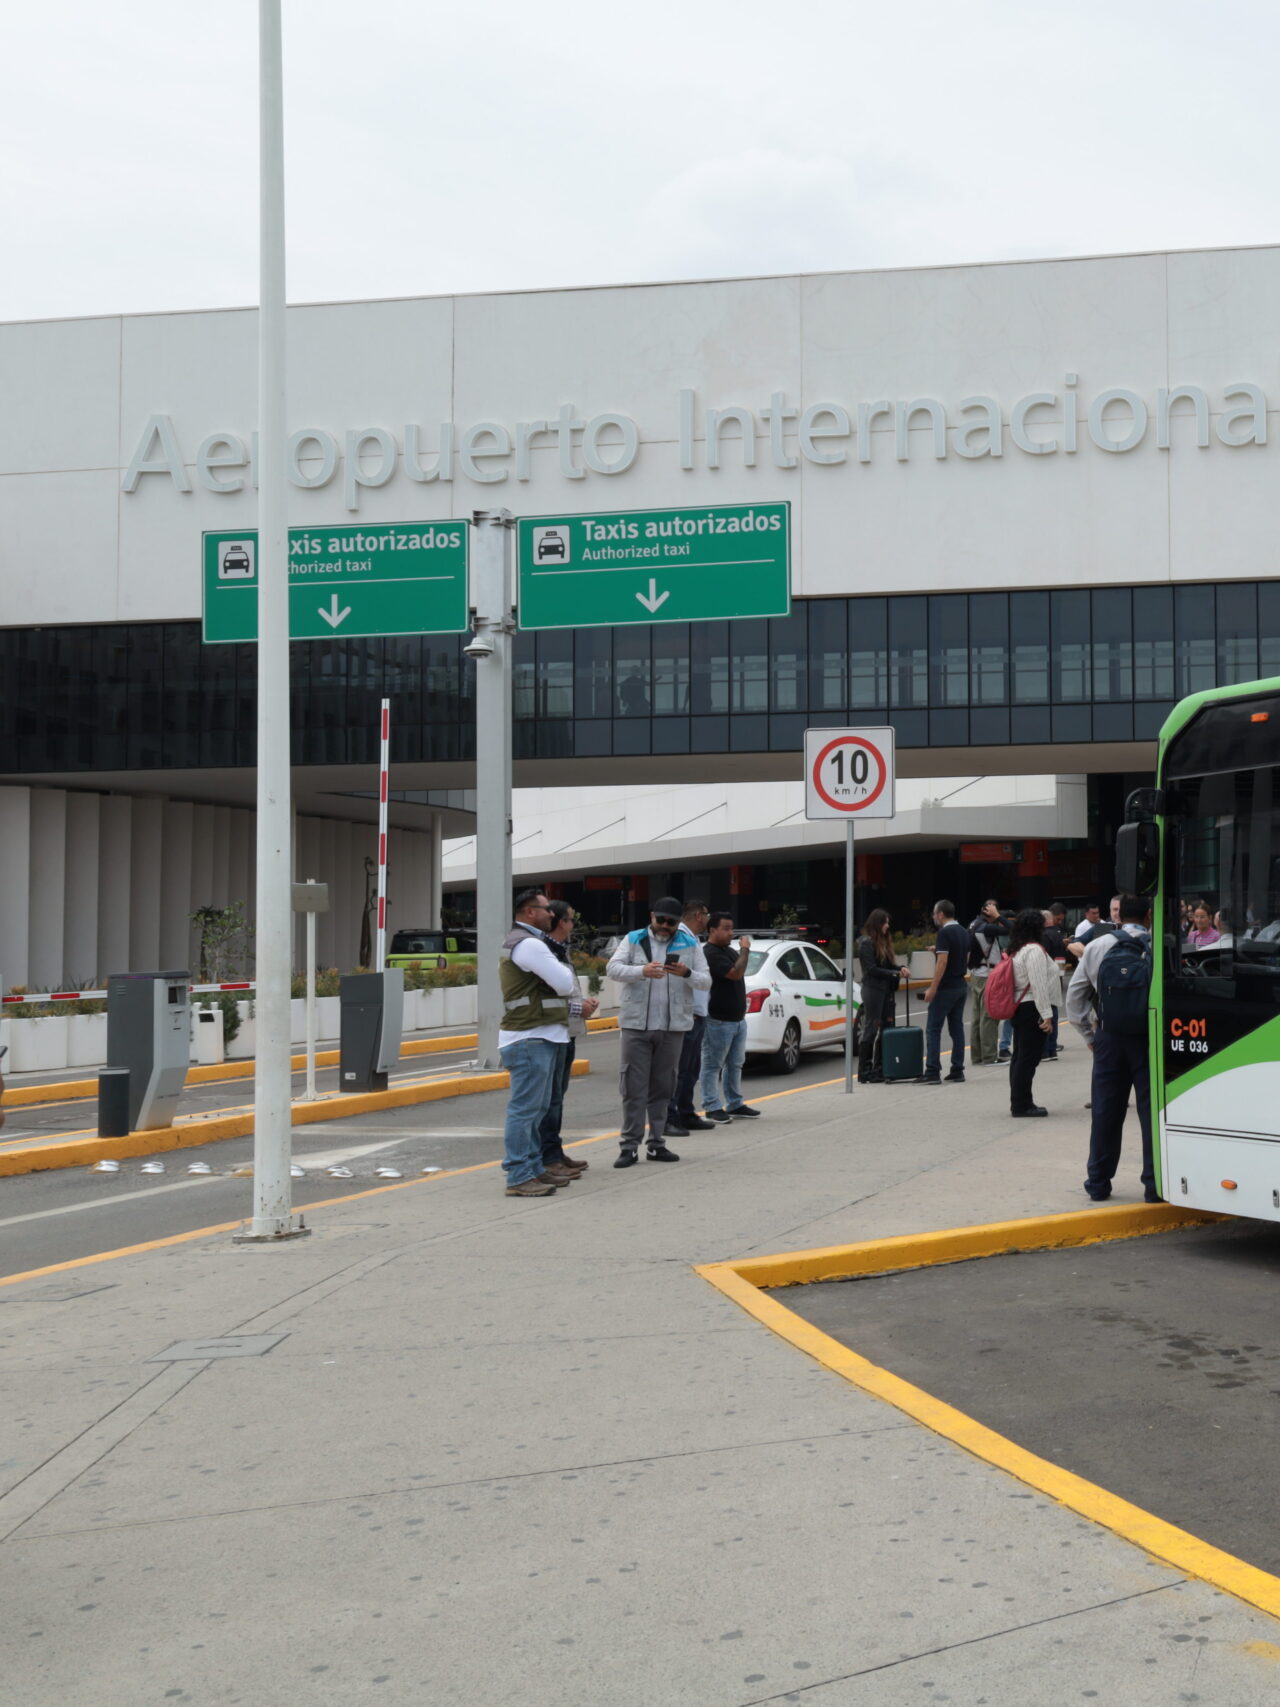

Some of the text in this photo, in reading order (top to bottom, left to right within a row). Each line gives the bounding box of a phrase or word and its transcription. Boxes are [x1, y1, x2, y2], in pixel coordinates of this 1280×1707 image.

[121, 403, 640, 511] Aeopuerto
[581, 510, 781, 542] Taxis autorizados
[288, 527, 461, 555] xis autorizados
[582, 542, 691, 561] Authorized taxi
[346, 558, 372, 572] taxi
[830, 749, 869, 785] 10
[1171, 1017, 1206, 1038] C-01
[1171, 1039, 1209, 1053] UE 036
